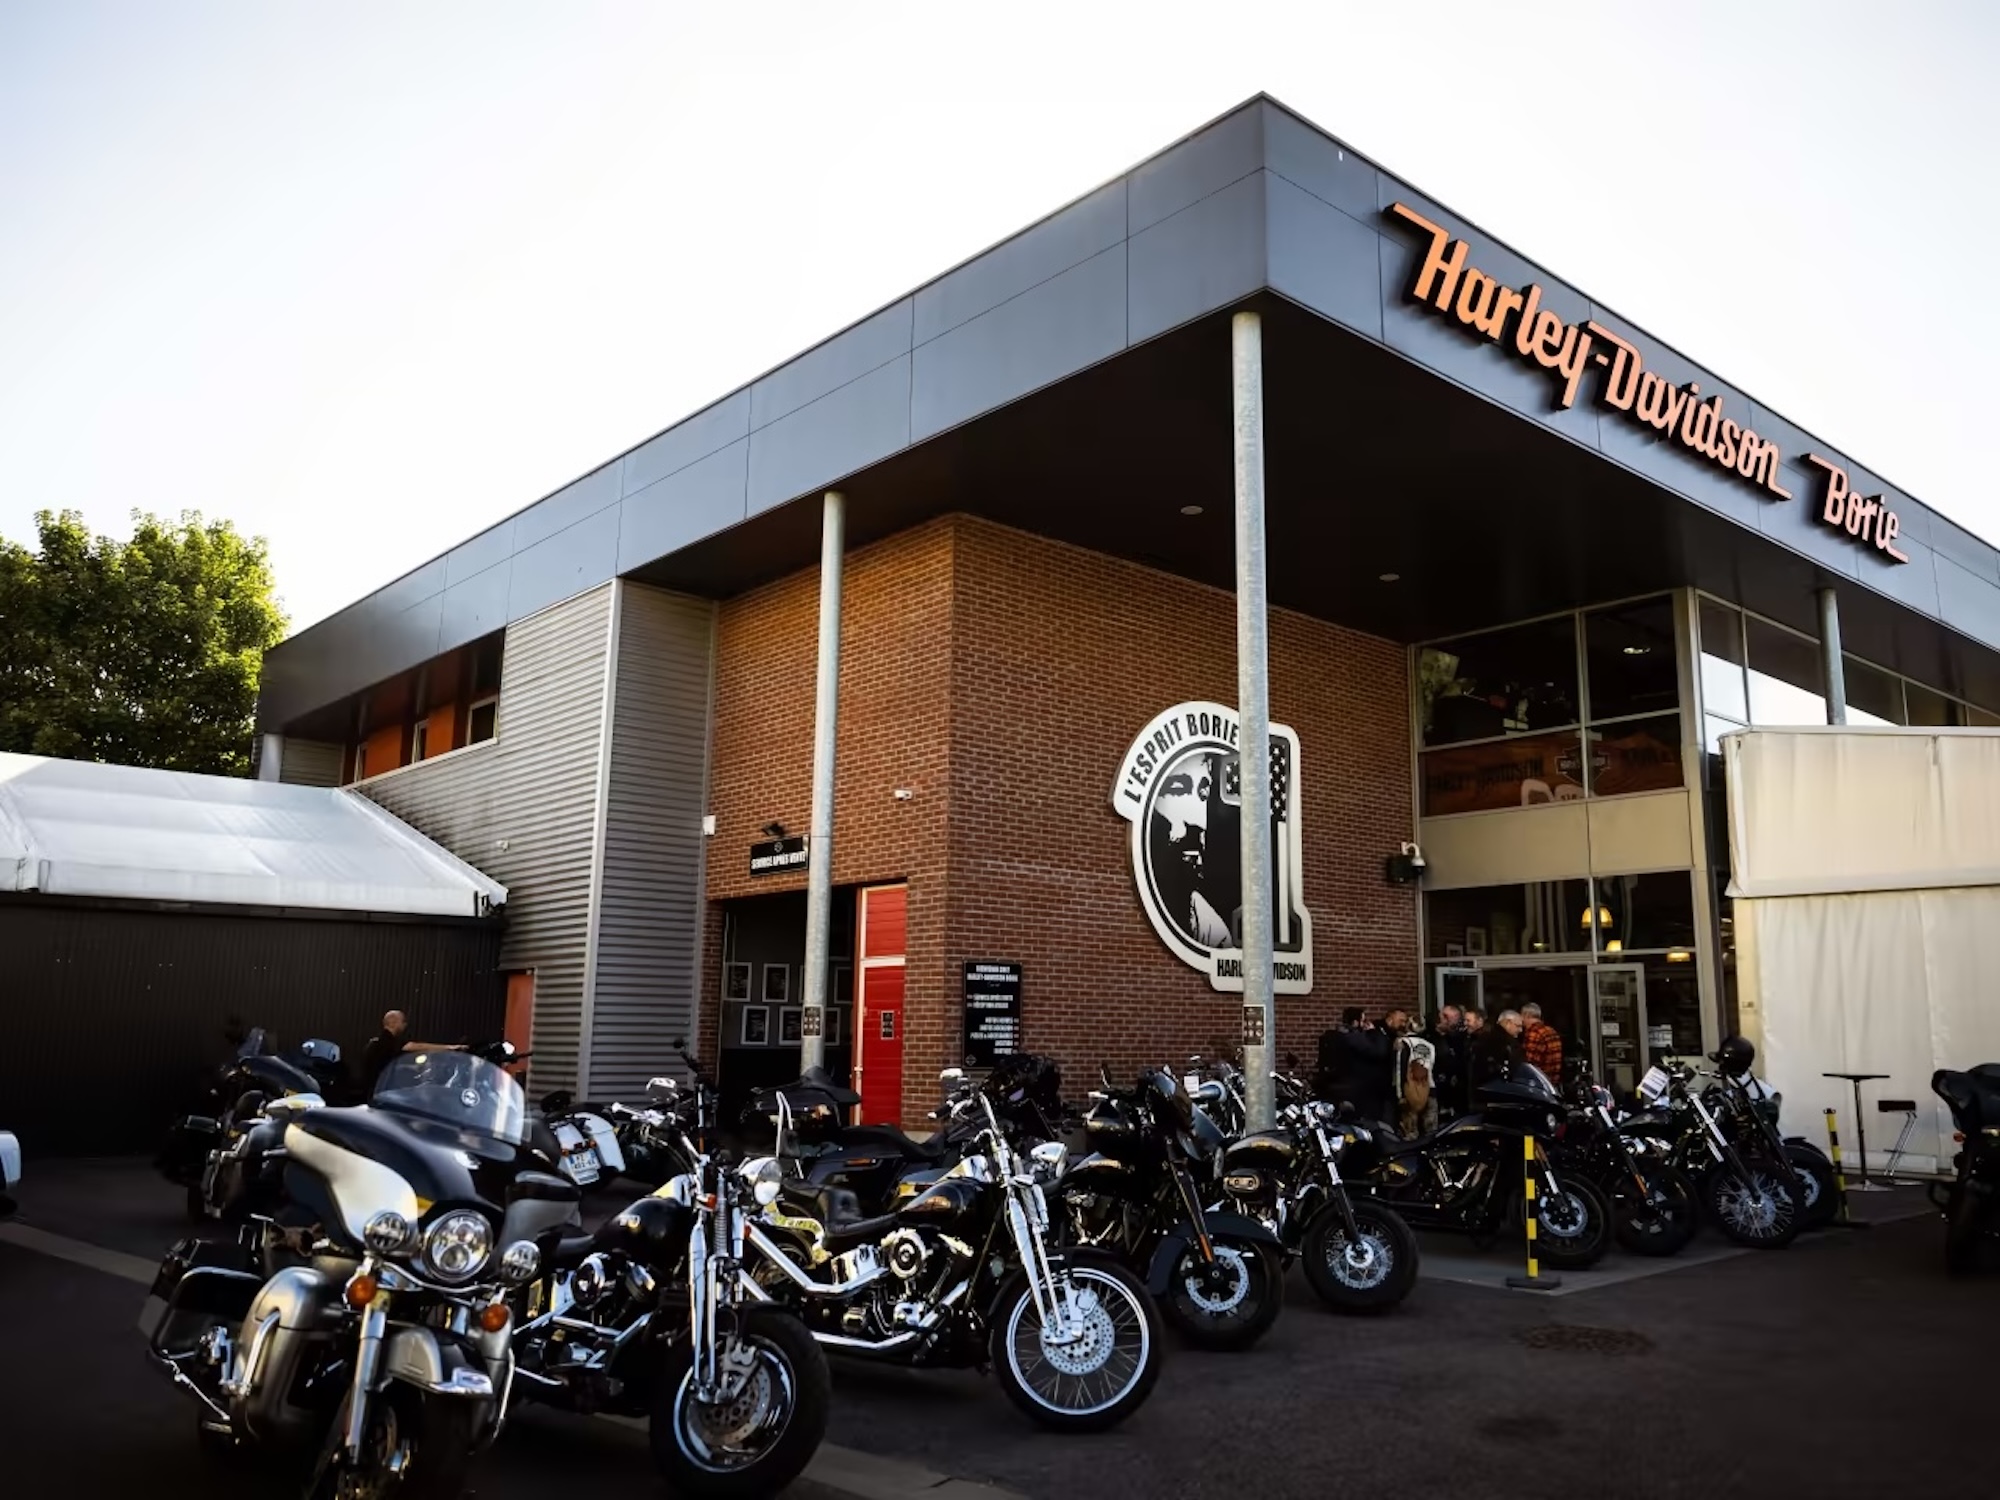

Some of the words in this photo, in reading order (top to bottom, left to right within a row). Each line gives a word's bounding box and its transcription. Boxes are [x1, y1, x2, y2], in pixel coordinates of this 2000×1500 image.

[1390, 202, 1793, 500] Harley-Davidson
[1808, 453, 1908, 564] Borie
[1124, 717, 1182, 803] L'ESPRIT
[1186, 712, 1239, 745] BORIE
